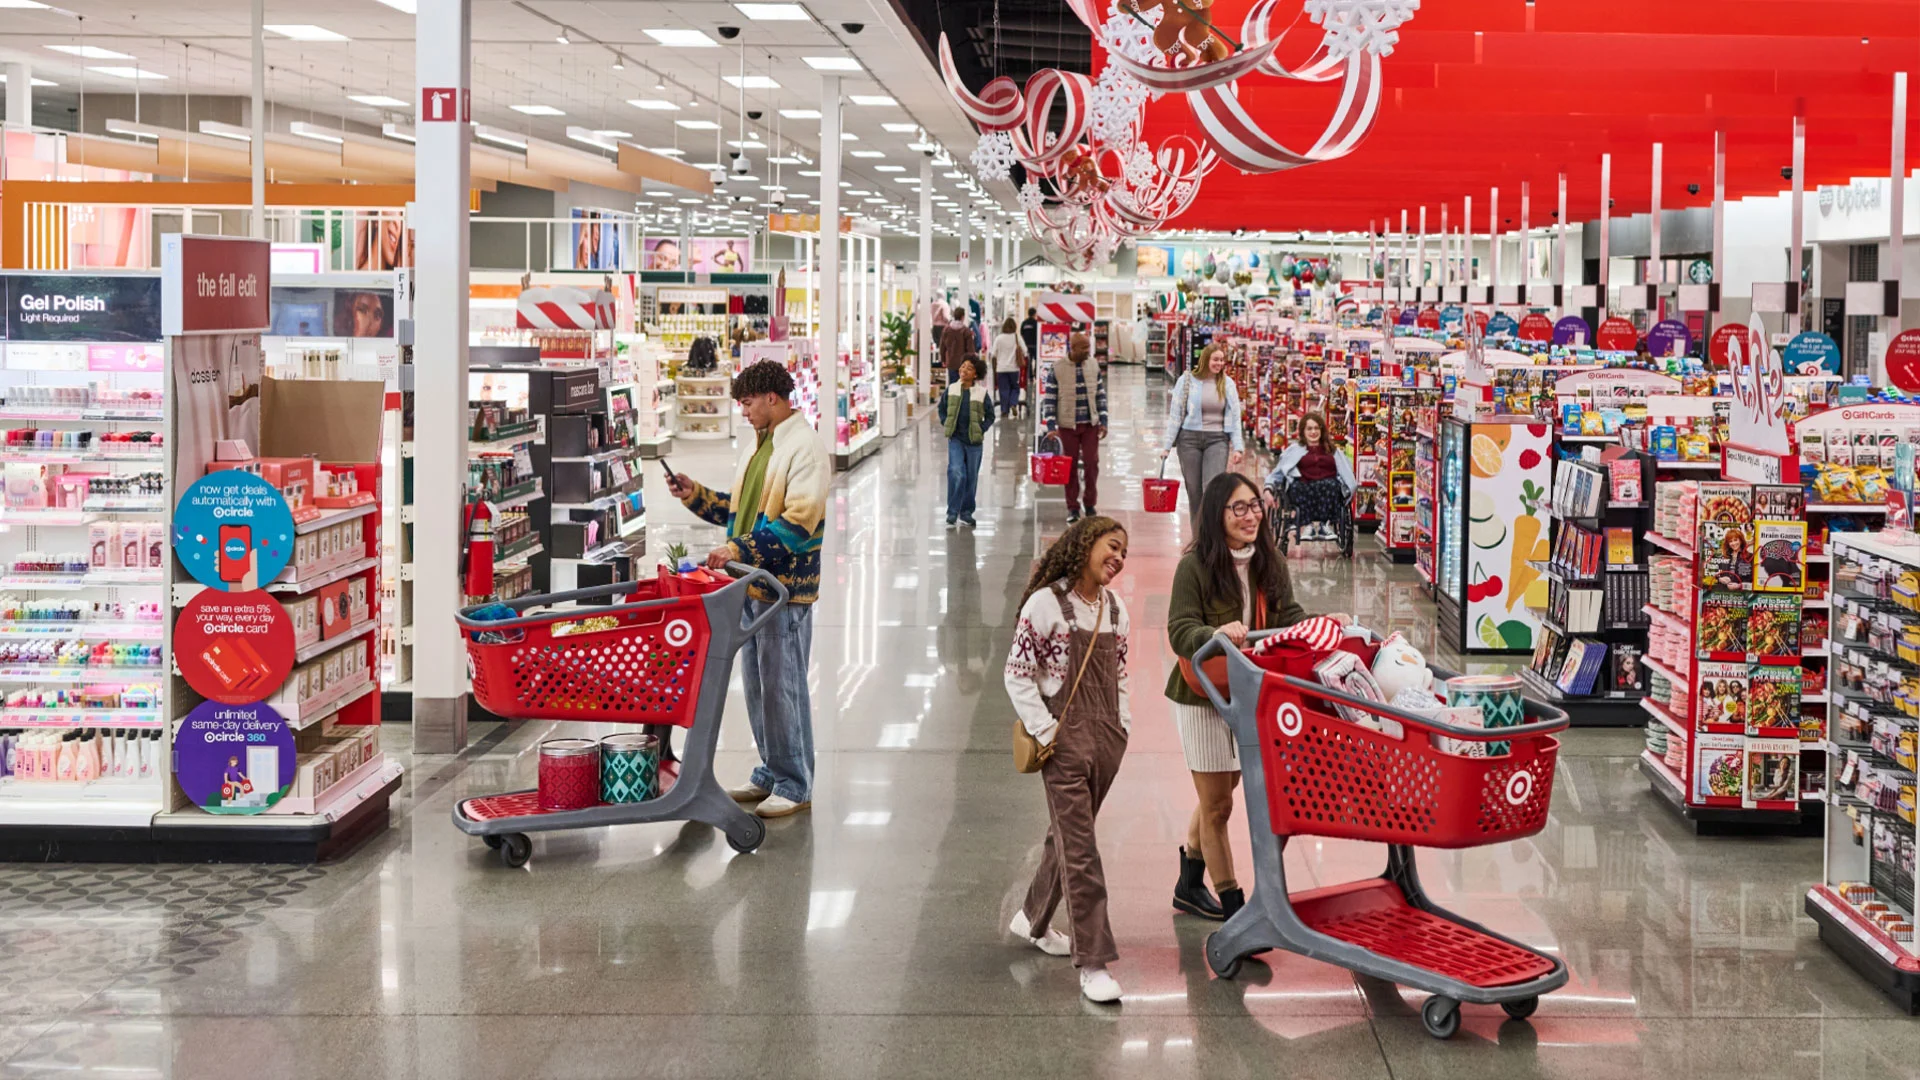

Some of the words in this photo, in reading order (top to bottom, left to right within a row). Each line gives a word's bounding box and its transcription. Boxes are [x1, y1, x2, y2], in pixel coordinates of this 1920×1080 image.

[1837, 180, 1881, 216] Optical
[197, 272, 216, 297] the
[219, 273, 236, 297] fall
[238, 273, 257, 297] edit
[20, 294, 49, 311] Gel
[53, 294, 106, 311] Polish
[20, 313, 41, 324] Light
[42, 313, 80, 324] Required
[191, 368, 221, 384] dossier
[1852, 410, 1895, 420] GiftCards
[200, 486, 221, 494] now
[223, 485, 239, 496] get
[241, 484, 268, 495] deals
[192, 496, 254, 507] automatically
[256, 496, 277, 506] with
[224, 506, 254, 517] circle
[1771, 505, 1786, 514] THE
[200, 605, 220, 613] save
[221, 605, 232, 613] an
[234, 605, 254, 613] extra
[256, 604, 271, 613] 5%
[1706, 599, 1748, 608] DIABETES
[1753, 603, 1796, 612] DIABETES
[196, 614, 214, 623] your
[216, 614, 233, 623] way,
[235, 614, 257, 623] every
[259, 613, 275, 624] day
[214, 622, 243, 633] circle
[245, 623, 268, 633] card
[1721, 671, 1747, 679] HALEN
[214, 709, 257, 720] unlimited
[191, 720, 241, 731] same-day
[243, 720, 280, 732] delivery
[215, 731, 245, 742] circle
[247, 733, 266, 742] 360
